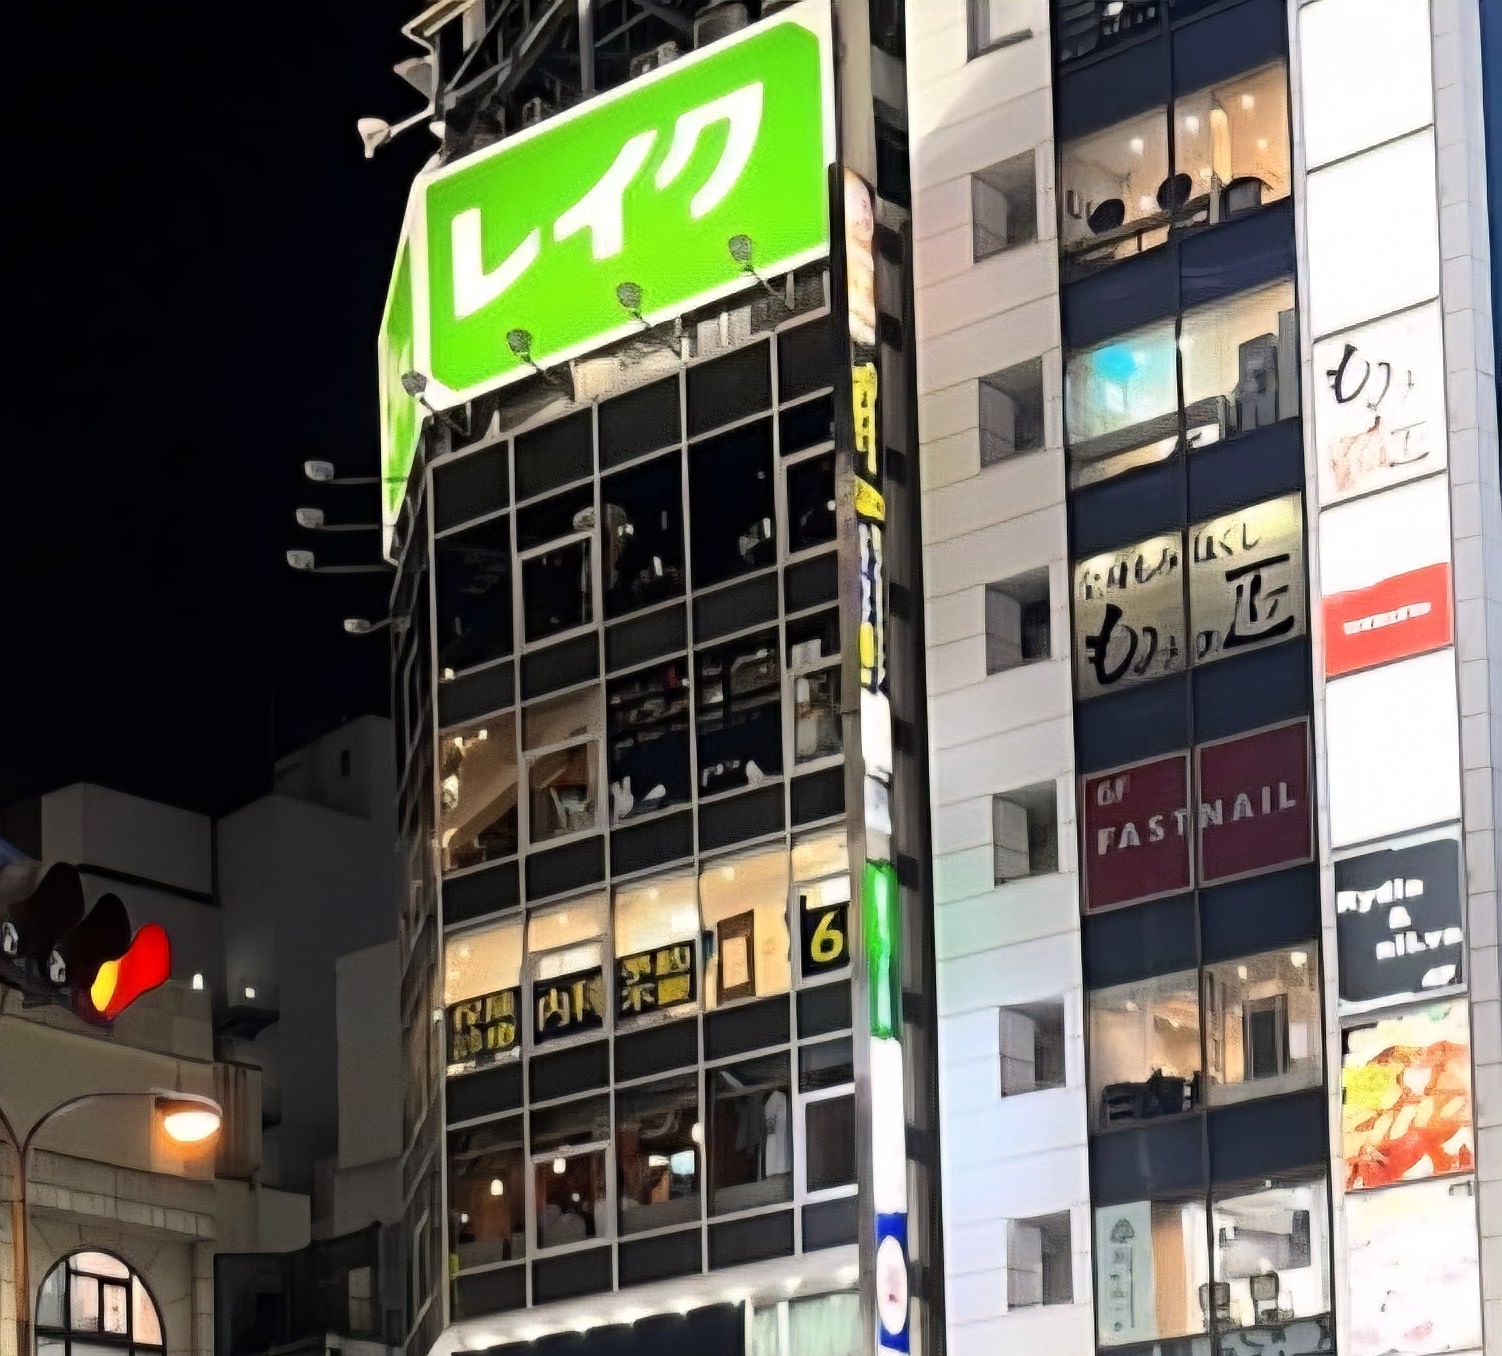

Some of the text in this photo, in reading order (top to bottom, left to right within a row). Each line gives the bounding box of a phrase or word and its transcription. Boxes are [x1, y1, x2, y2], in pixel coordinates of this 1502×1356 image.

[451, 82, 764, 320] レイク
[810, 911, 845, 963] 6
